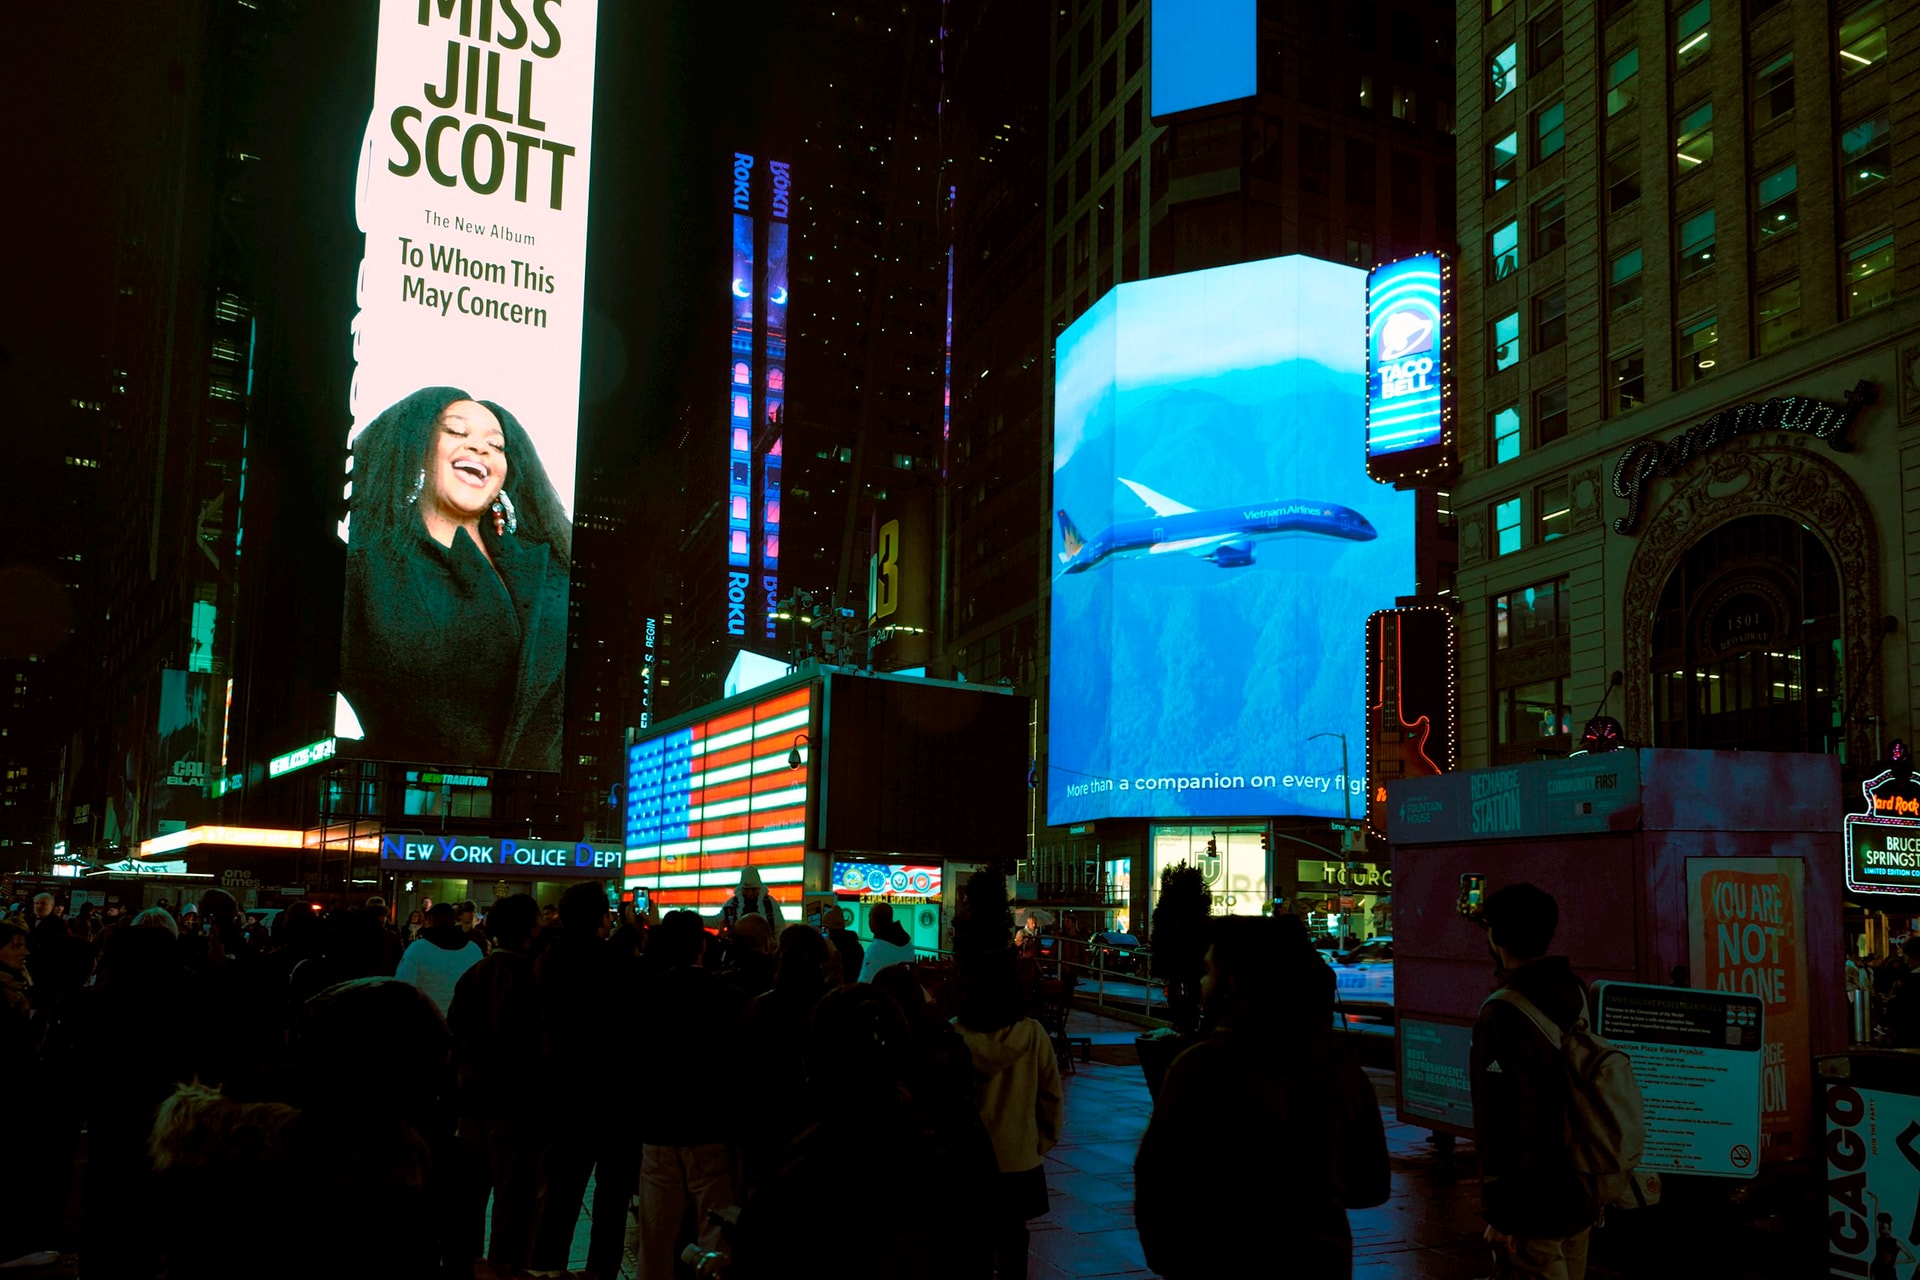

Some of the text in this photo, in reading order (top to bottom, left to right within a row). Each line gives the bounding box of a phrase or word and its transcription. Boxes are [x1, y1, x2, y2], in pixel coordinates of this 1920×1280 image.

[424, 39, 546, 132] JILL
[388, 105, 576, 211] SCOTT
[425, 209, 535, 246] The New Album
[398, 236, 555, 294] To Whom This
[402, 274, 547, 329] May Concern
[1377, 357, 1434, 383] TACO
[1381, 374, 1433, 400] BELL
[1612, 380, 1877, 535] Paramount
[1243, 504, 1321, 520] Vietnam Airlines
[1728, 611, 1759, 631] 1501
[1720, 632, 1769, 650] BROADWAY
[1066, 784, 1089, 798] More
[1090, 779, 1113, 793] than
[1119, 780, 1129, 790] a
[1135, 772, 1245, 796] companion
[1250, 776, 1275, 787] on
[1282, 776, 1331, 792] every
[1470, 769, 1520, 801] RECHARGE
[1407, 801, 1443, 814] FOUNTAIN
[1407, 812, 1432, 824] HOUSE
[1471, 788, 1521, 834] STATION
[1895, 796, 1920, 816] Rock
[1886, 836, 1920, 853] BRUCE
[221, 876, 261, 888] times
[224, 867, 252, 878] one
[1864, 867, 1886, 876] LIMITED
[1887, 868, 1910, 877] EDITION
[1715, 881, 1784, 924] YOU ARE
[1717, 922, 1785, 969] NOT
[1716, 967, 1786, 1005] ALONE
